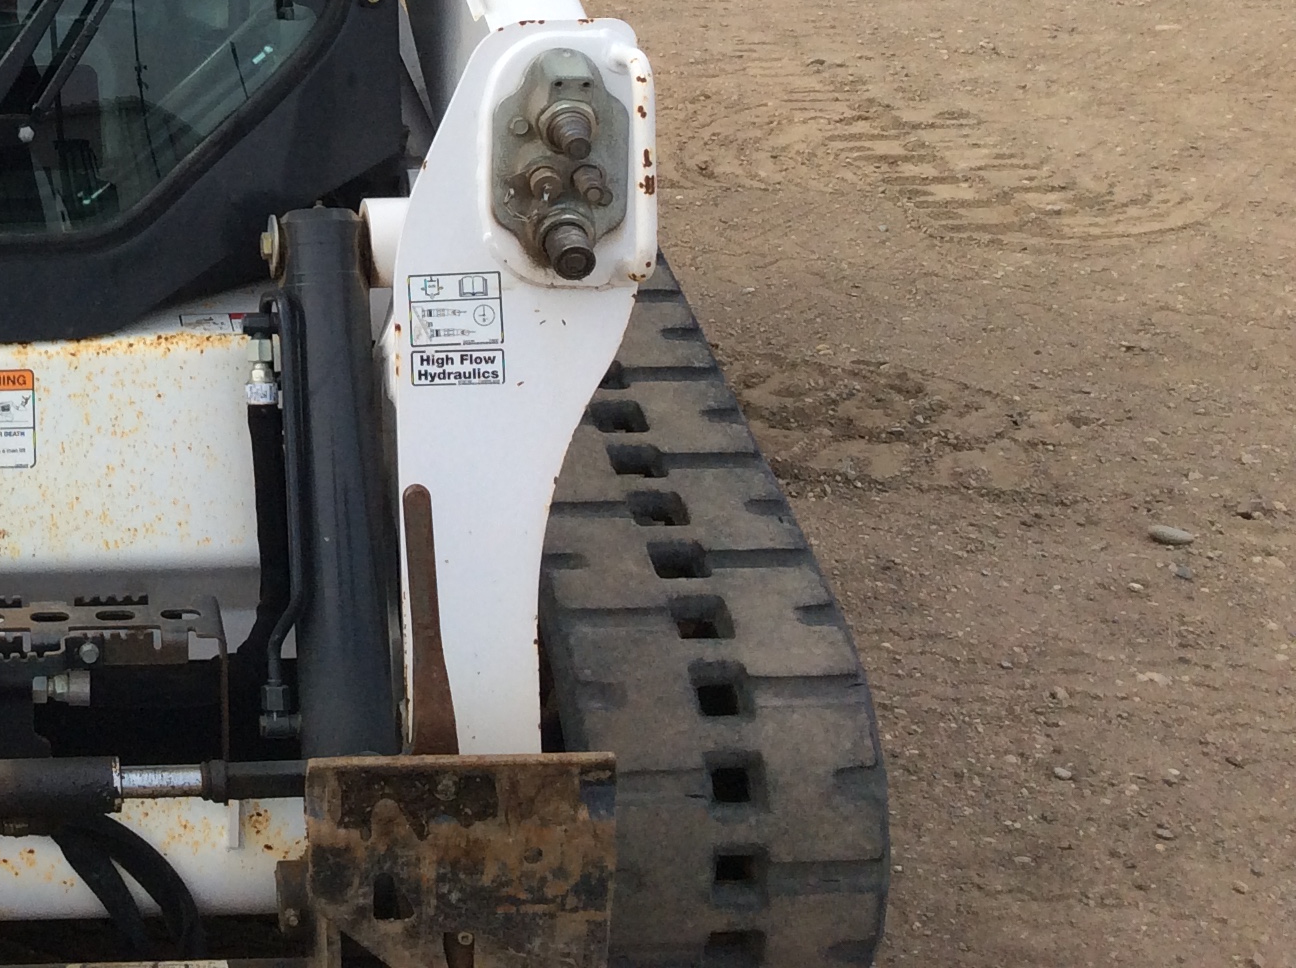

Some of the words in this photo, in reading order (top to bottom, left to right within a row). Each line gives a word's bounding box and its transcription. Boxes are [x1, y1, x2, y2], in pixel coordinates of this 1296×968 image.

[420, 354, 455, 368] High
[459, 354, 497, 366] Flow
[417, 368, 500, 383] Hydraulics
